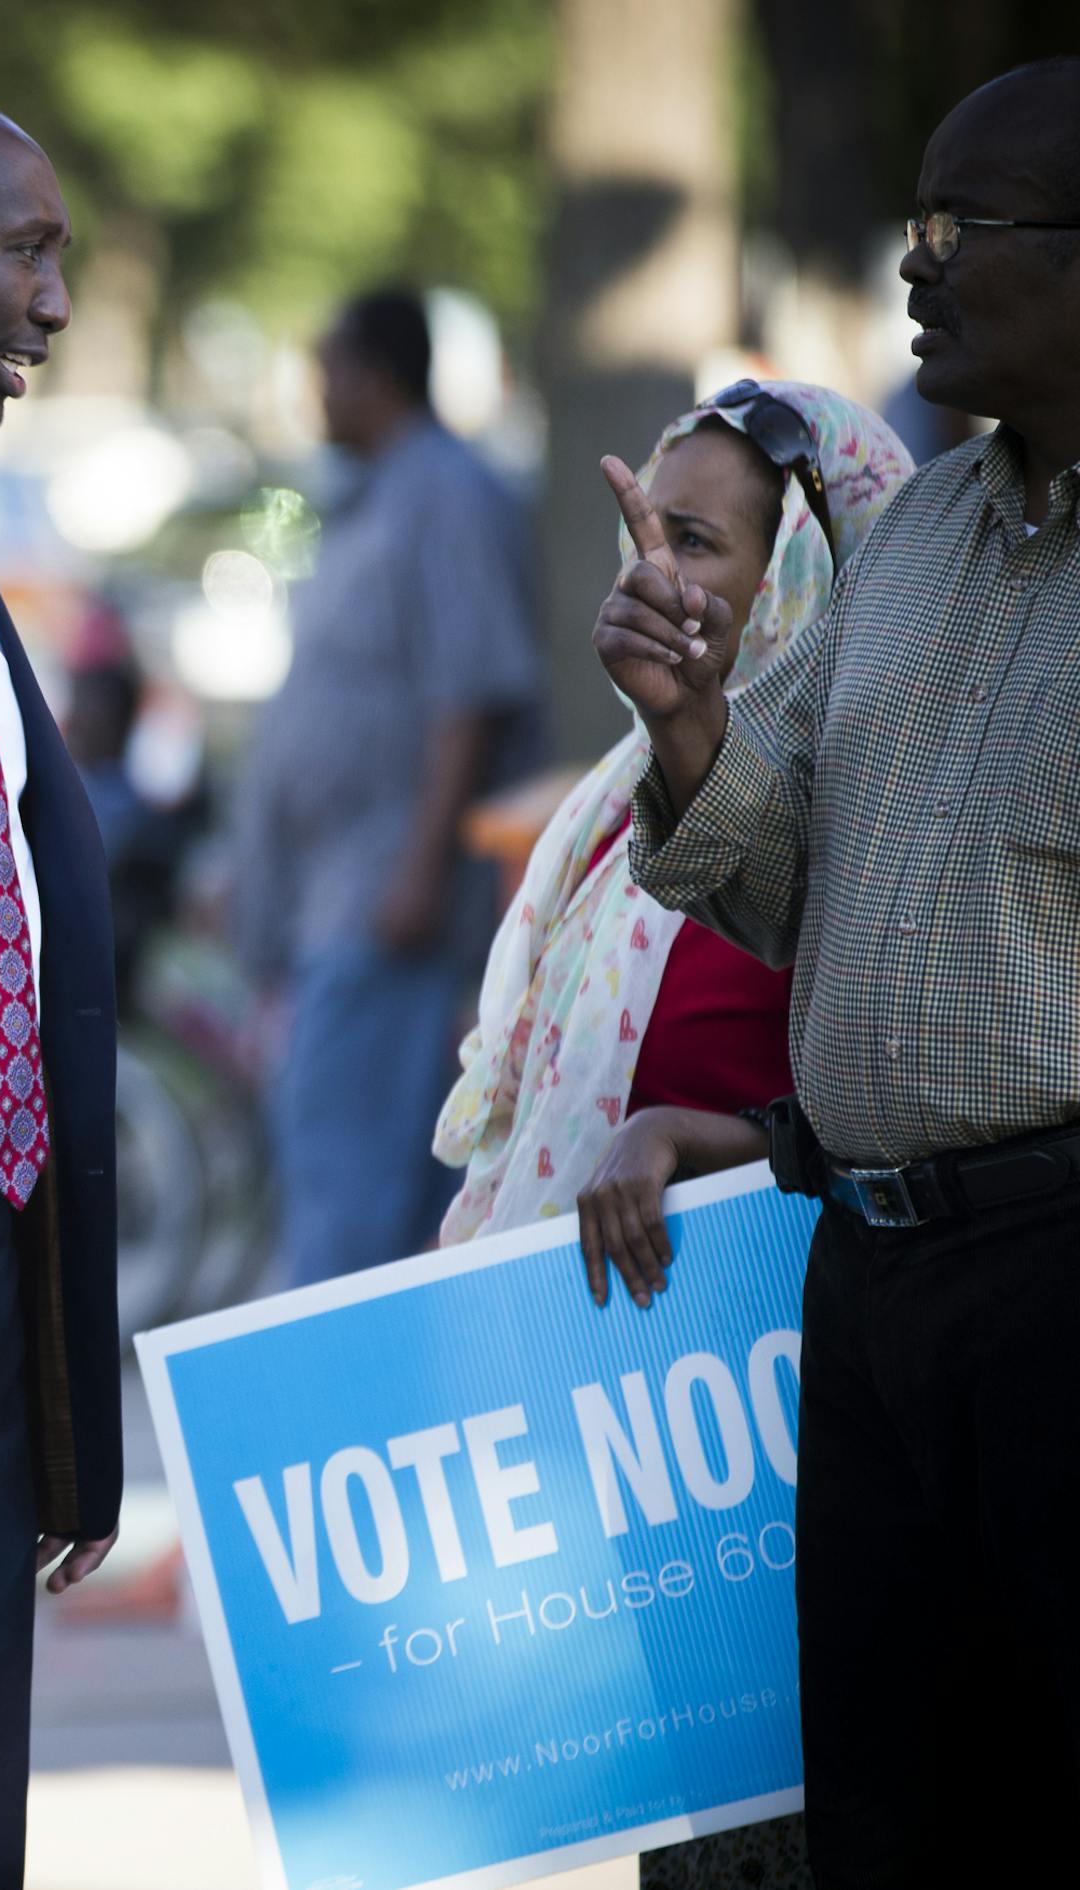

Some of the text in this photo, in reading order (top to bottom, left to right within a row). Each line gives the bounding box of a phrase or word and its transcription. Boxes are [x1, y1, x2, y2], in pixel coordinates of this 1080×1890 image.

[232, 1403, 559, 1625] VOTE
[378, 1617, 466, 1673] for
[486, 1558, 695, 1646] House
[444, 1681, 800, 1791] www.NoorForHouse.
